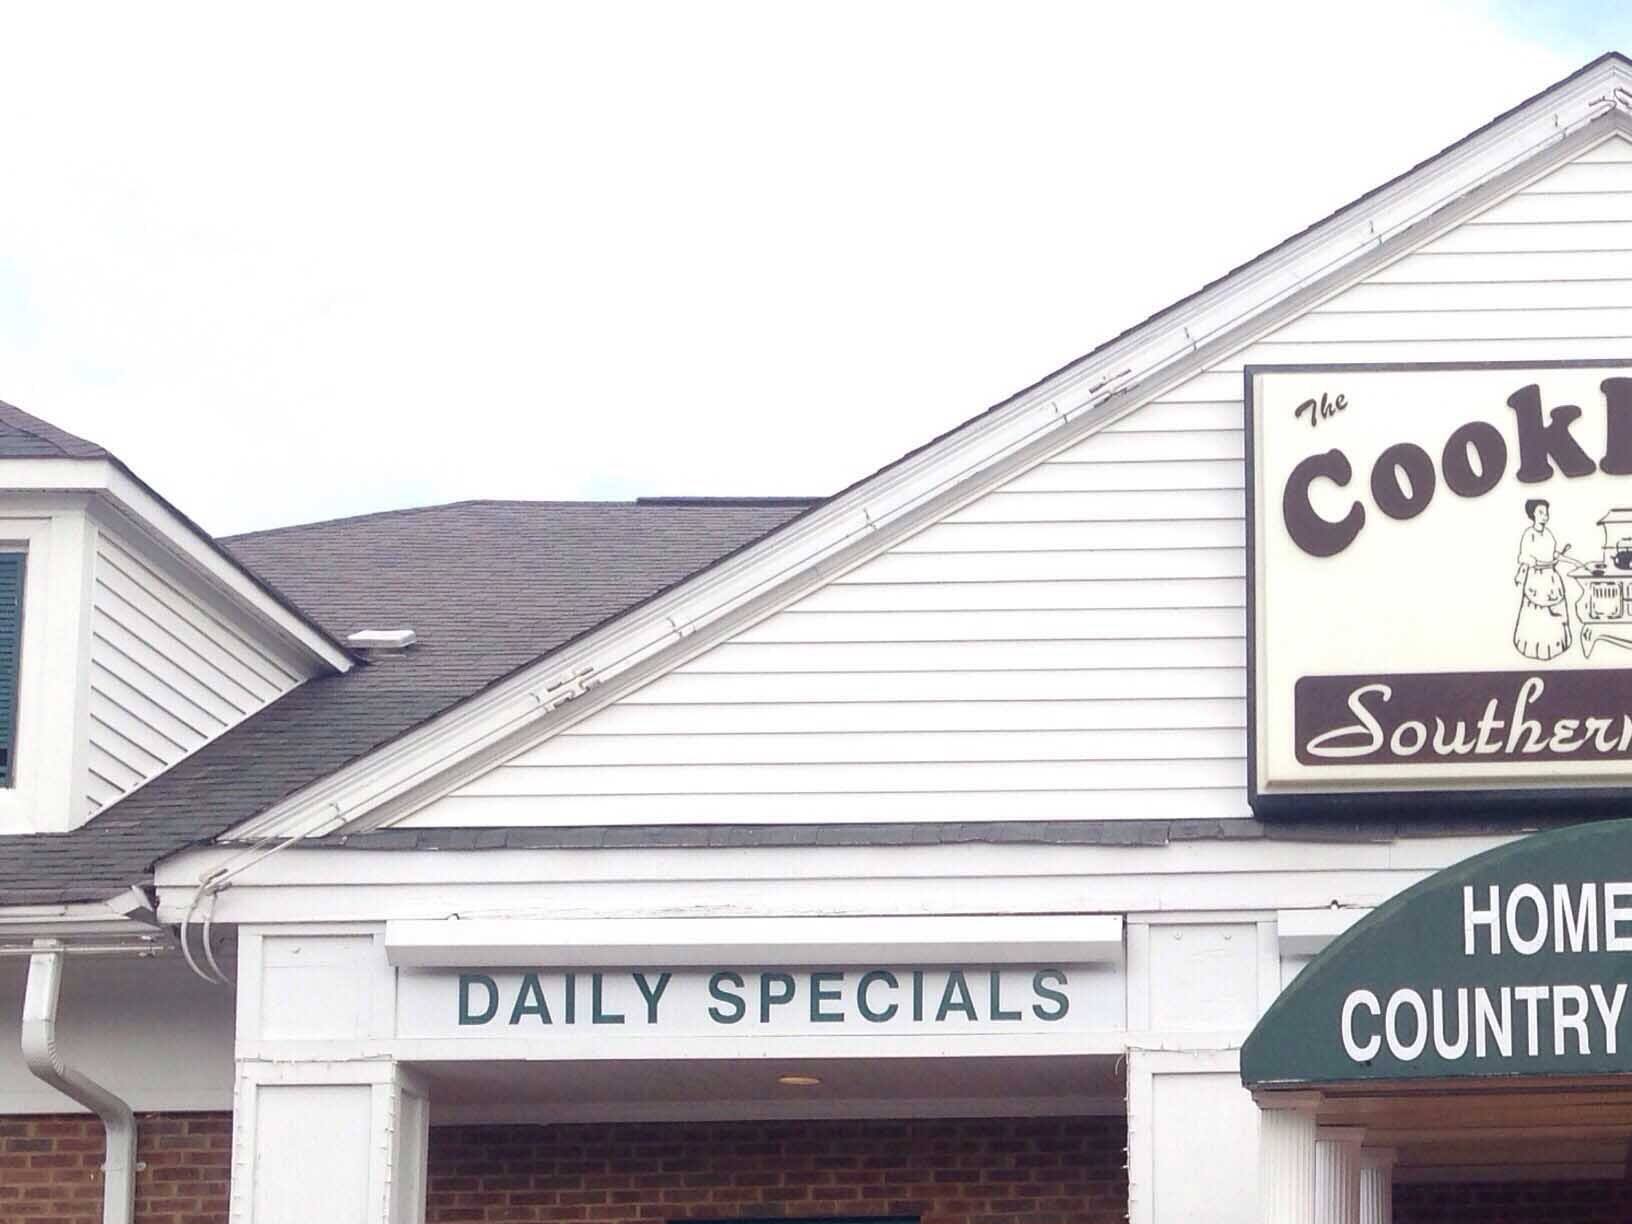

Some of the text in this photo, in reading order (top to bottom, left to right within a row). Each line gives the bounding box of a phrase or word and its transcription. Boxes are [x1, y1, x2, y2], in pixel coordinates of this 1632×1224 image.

[1294, 391, 1349, 428] The
[457, 968, 1071, 1026] DAILY SPECIALS
[1341, 982, 1630, 1063] COUNTRY
